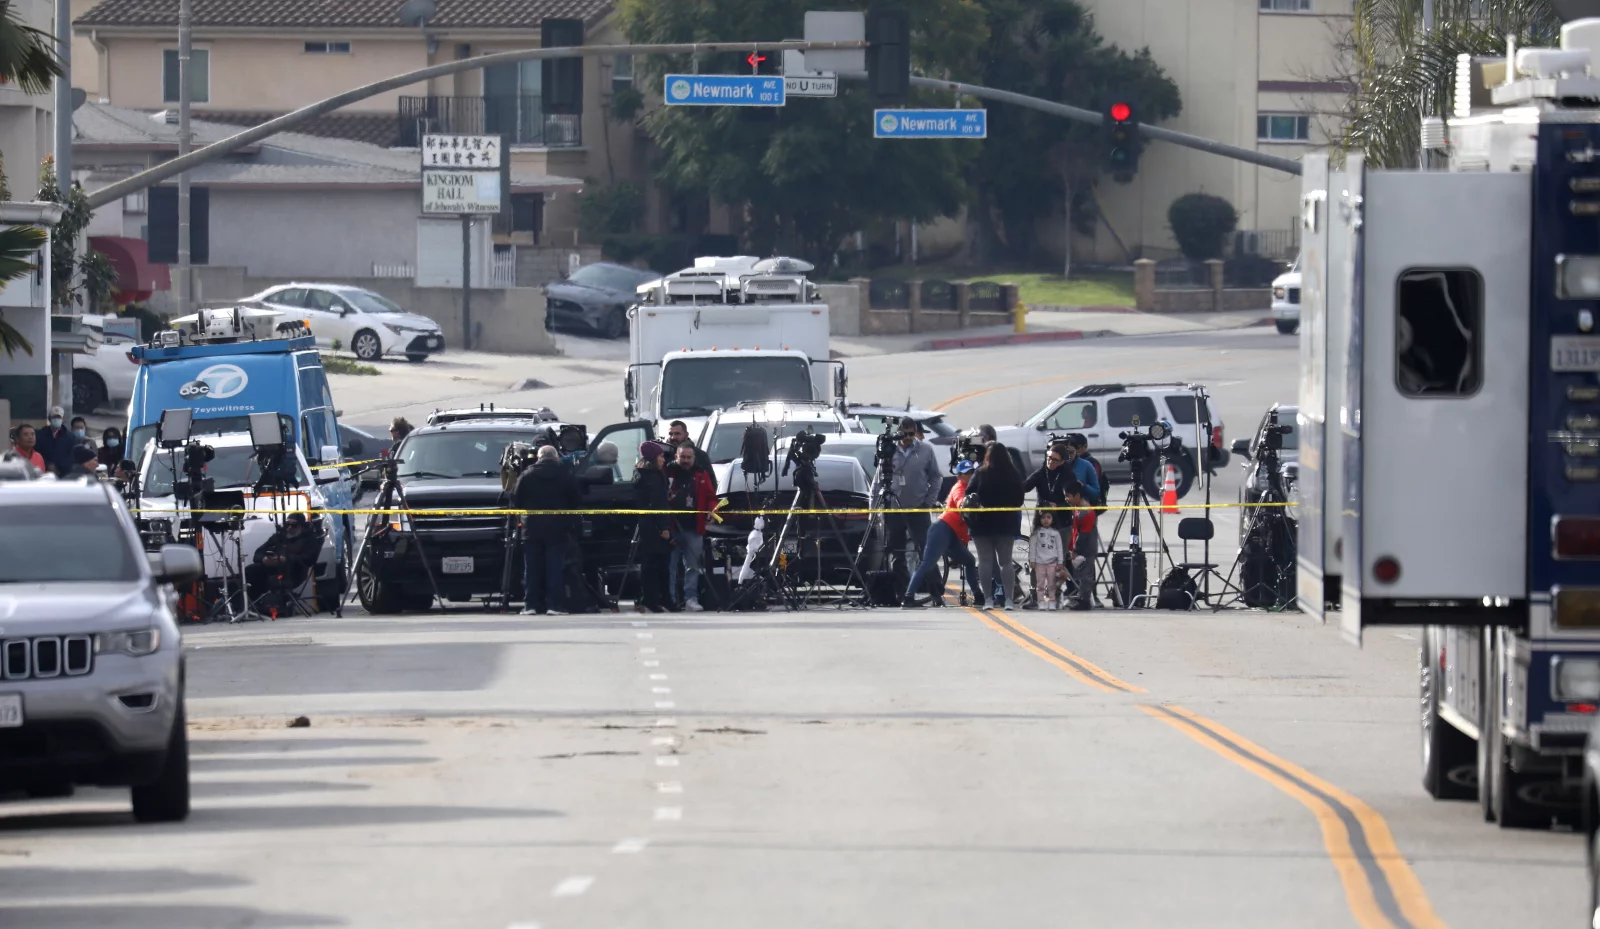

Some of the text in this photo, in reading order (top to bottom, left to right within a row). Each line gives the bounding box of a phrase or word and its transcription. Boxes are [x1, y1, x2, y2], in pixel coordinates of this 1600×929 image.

[693, 82, 754, 99] Newmark
[763, 80, 777, 90] AVE
[786, 81, 833, 92] NO U TURN
[759, 92, 779, 102] 100 E
[965, 113, 978, 123] AVE
[901, 116, 957, 132] Newmark
[961, 123, 973, 133] 100
[426, 174, 474, 187] KINGDOM
[437, 187, 464, 200] HALL
[425, 202, 499, 211] of Jehovah's Witnesses
[179, 385, 210, 396] abc
